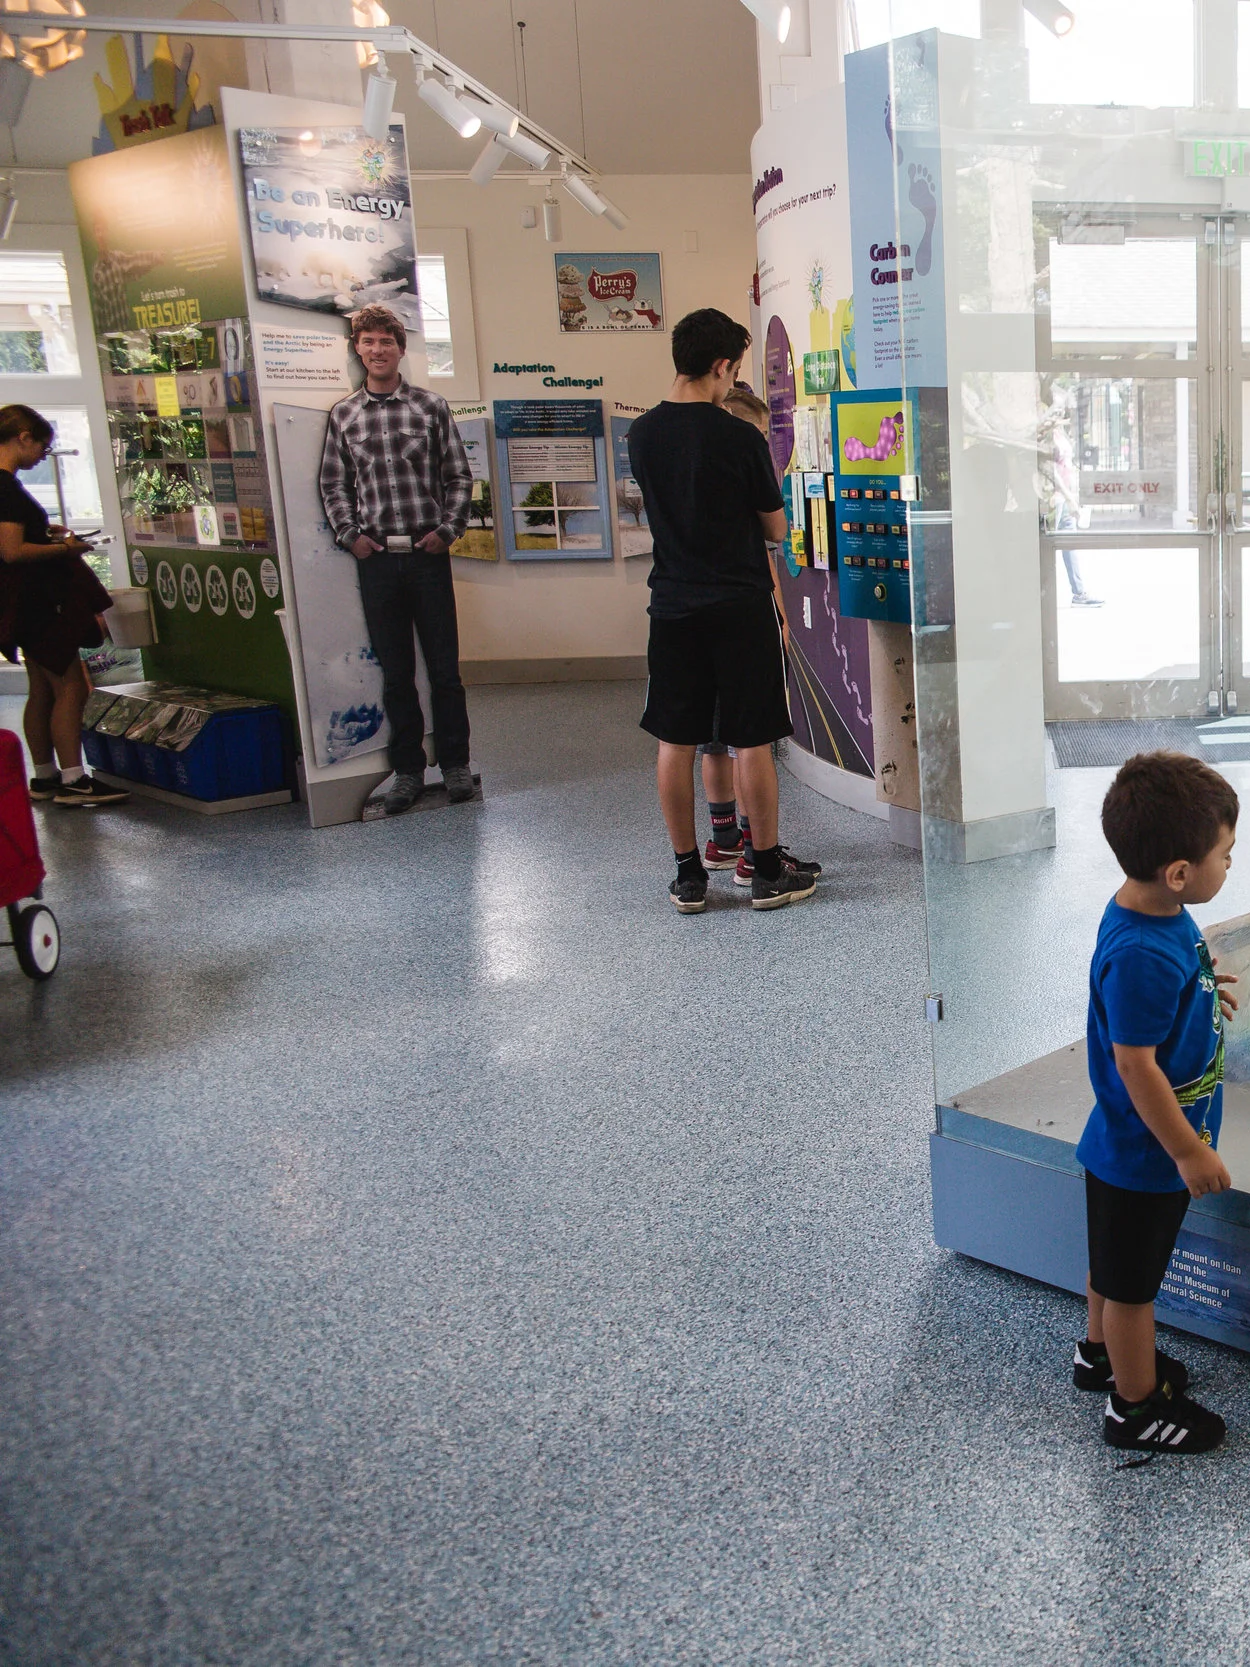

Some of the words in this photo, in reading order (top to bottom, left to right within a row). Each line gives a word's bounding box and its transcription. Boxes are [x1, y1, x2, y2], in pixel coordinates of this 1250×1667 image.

[1193, 140, 1248, 176] EXIT
[253, 178, 285, 203] Be
[291, 189, 320, 207] an
[325, 186, 404, 221] Energy
[798, 194, 808, 209] your
[809, 189, 822, 201] next
[822, 183, 836, 200] trip?
[257, 210, 385, 244] Superhero!
[870, 241, 911, 262] Carbn
[594, 276, 631, 291] Perry's
[870, 267, 914, 285] Couner
[610, 287, 631, 295] Cream
[132, 299, 201, 329] TREASURE!
[493, 363, 556, 376] Adaptation
[542, 376, 603, 389] Challenge!
[614, 402, 650, 413] Thermos
[1093, 482, 1123, 494] EXIT
[1127, 482, 1160, 493] ONLY
[713, 816, 733, 824] RIGHT
[1172, 1247, 1181, 1255] ar
[1182, 1252, 1208, 1265] mount
[1210, 1259, 1221, 1269] on
[1222, 1262, 1241, 1275] loan
[1172, 1258, 1191, 1273] from
[1193, 1265, 1207, 1277] the
[1164, 1270, 1182, 1282] ston
[1184, 1275, 1219, 1295] Museum
[1221, 1288, 1230, 1298] of
[1189, 1291, 1222, 1308] Science
